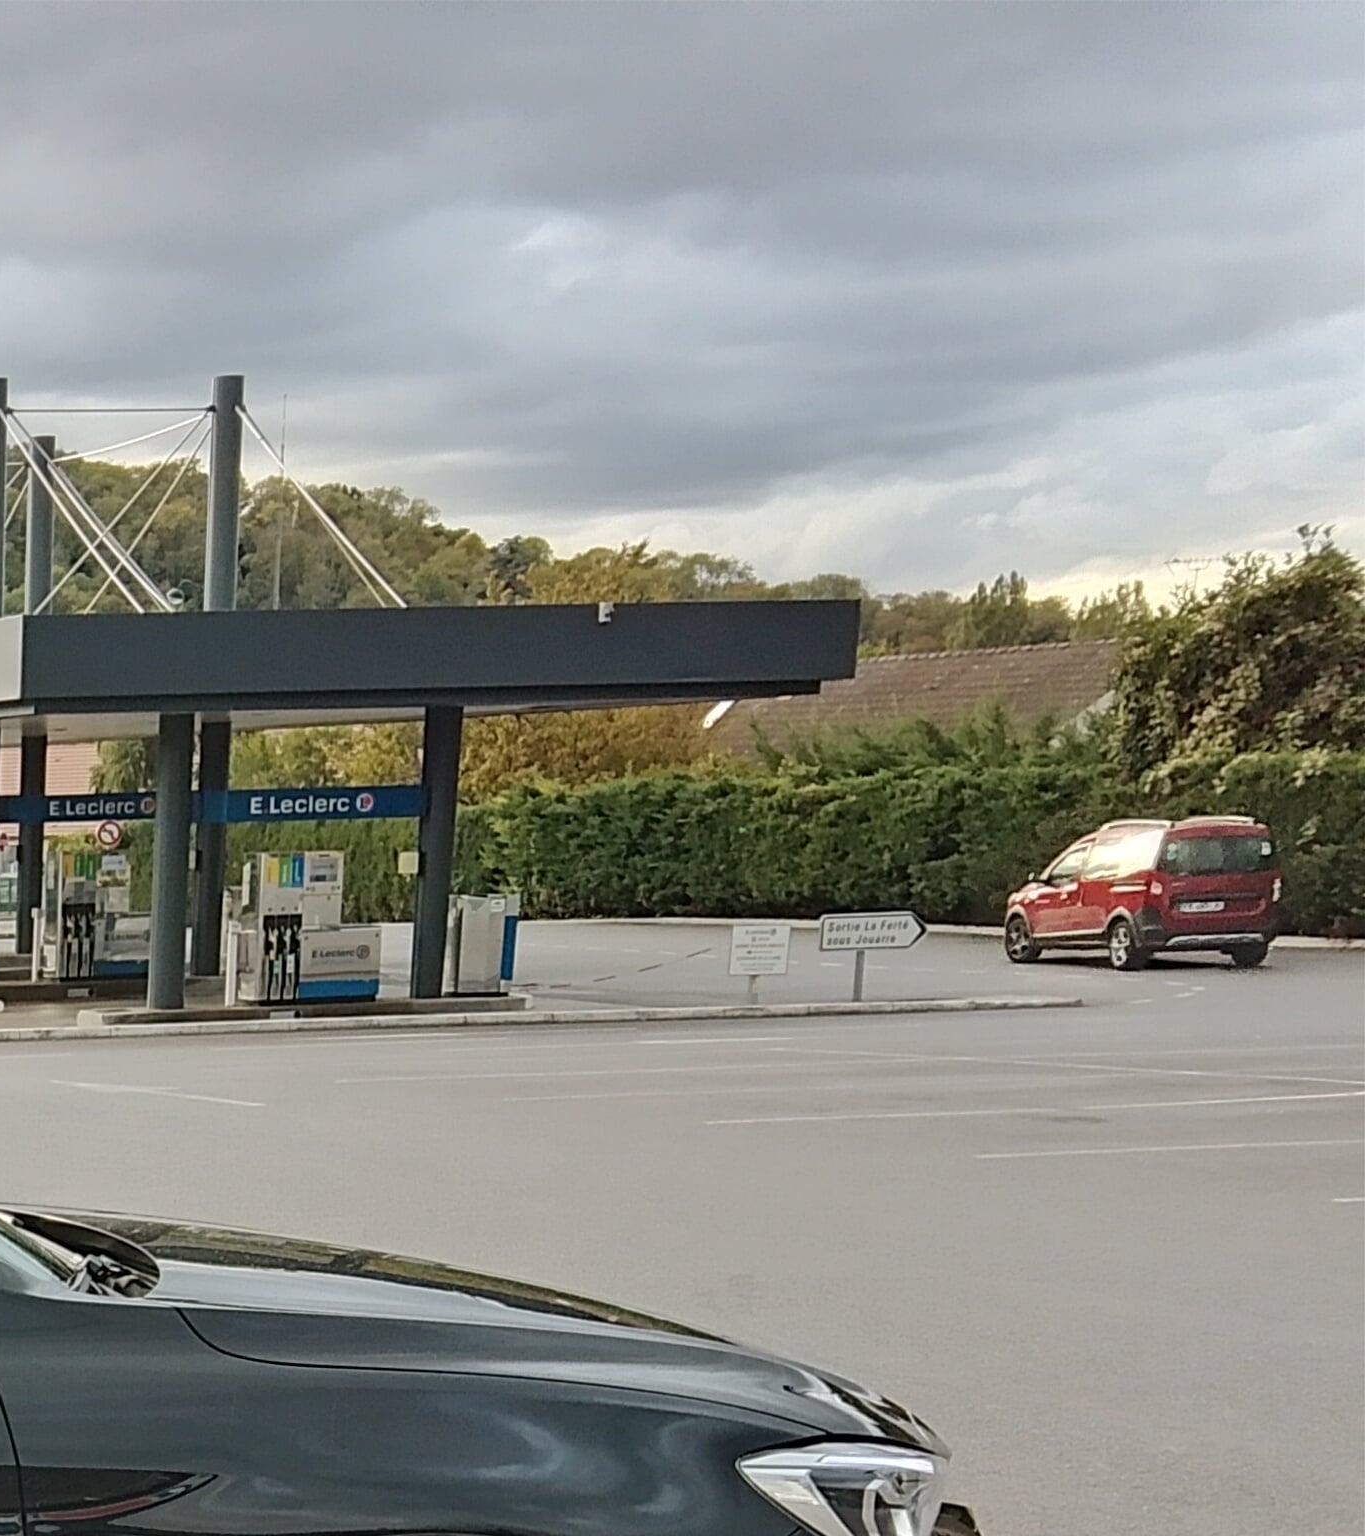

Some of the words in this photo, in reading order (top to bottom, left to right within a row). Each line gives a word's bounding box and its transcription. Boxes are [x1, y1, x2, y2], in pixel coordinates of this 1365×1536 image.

[828, 922, 861, 932] Sortie
[864, 921, 876, 931] La
[880, 919, 909, 930] Ferté
[826, 937, 851, 946] sous
[855, 934, 897, 945] Jouarre
